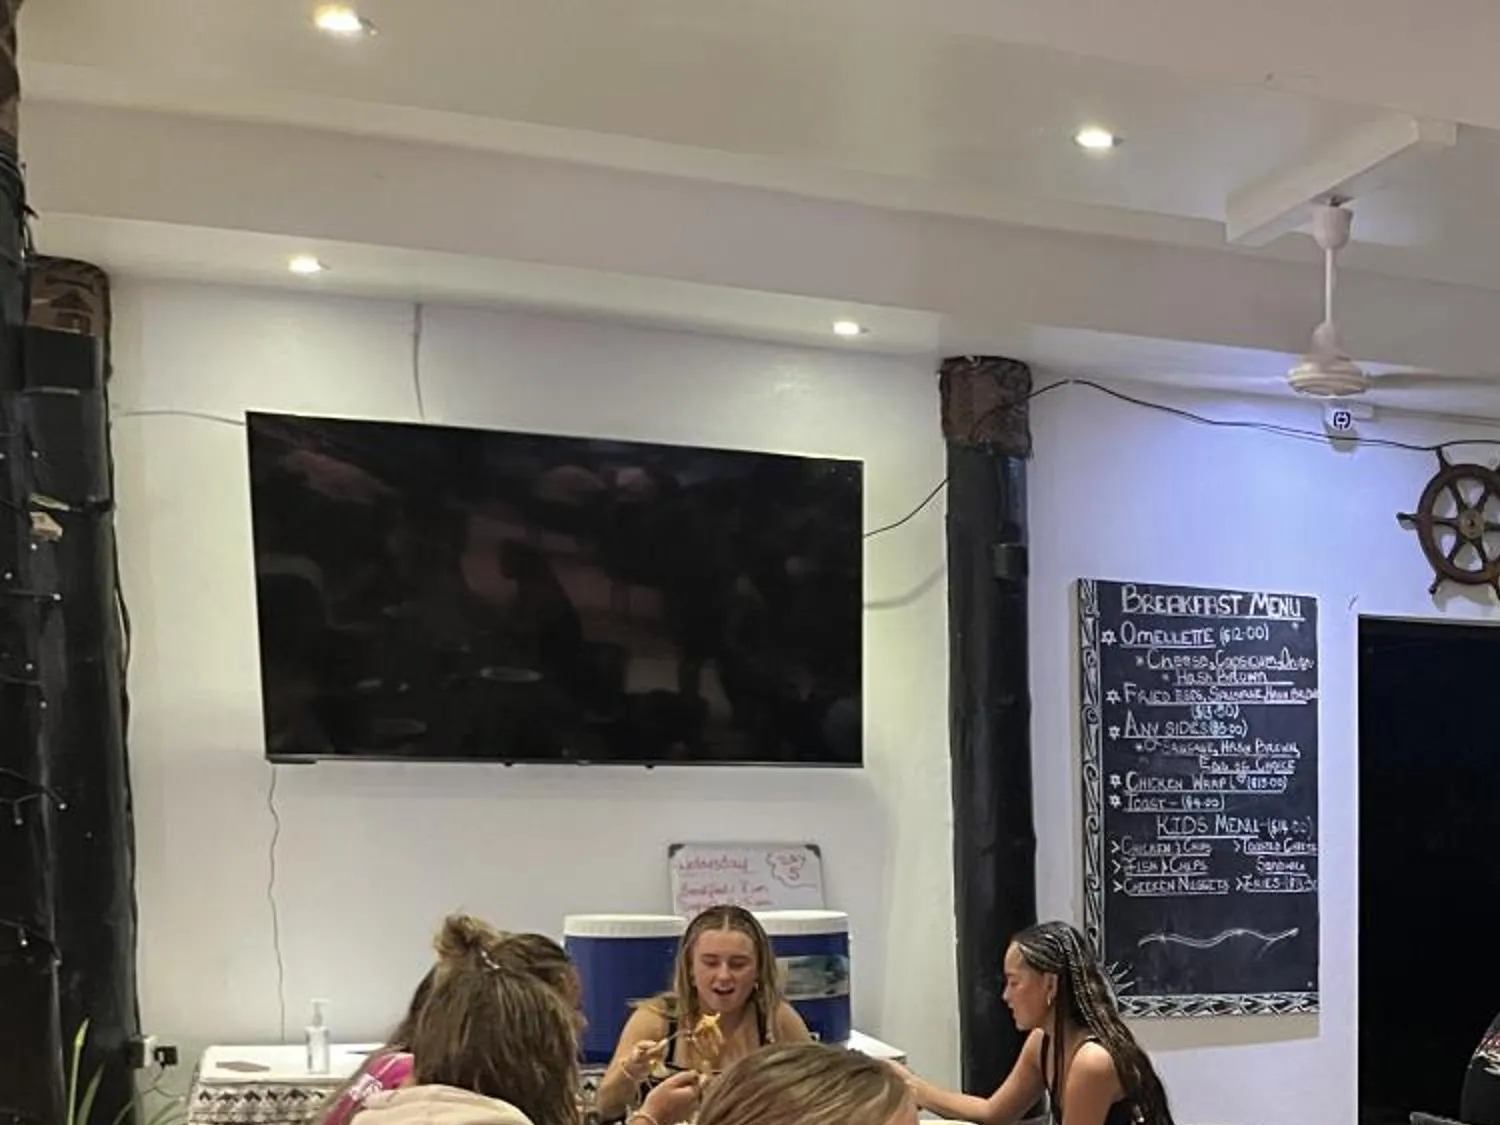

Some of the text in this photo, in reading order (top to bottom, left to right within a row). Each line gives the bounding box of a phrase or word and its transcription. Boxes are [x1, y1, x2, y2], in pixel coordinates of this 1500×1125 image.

[1120, 583, 1301, 617] BREAKFAST MENU
[1125, 709, 1159, 737] ANY
[1165, 721, 1208, 736] SIDES
[1126, 771, 1182, 791] CHICKEN
[1157, 815, 1208, 835] KIDS
[1215, 814, 1260, 834] MENU
